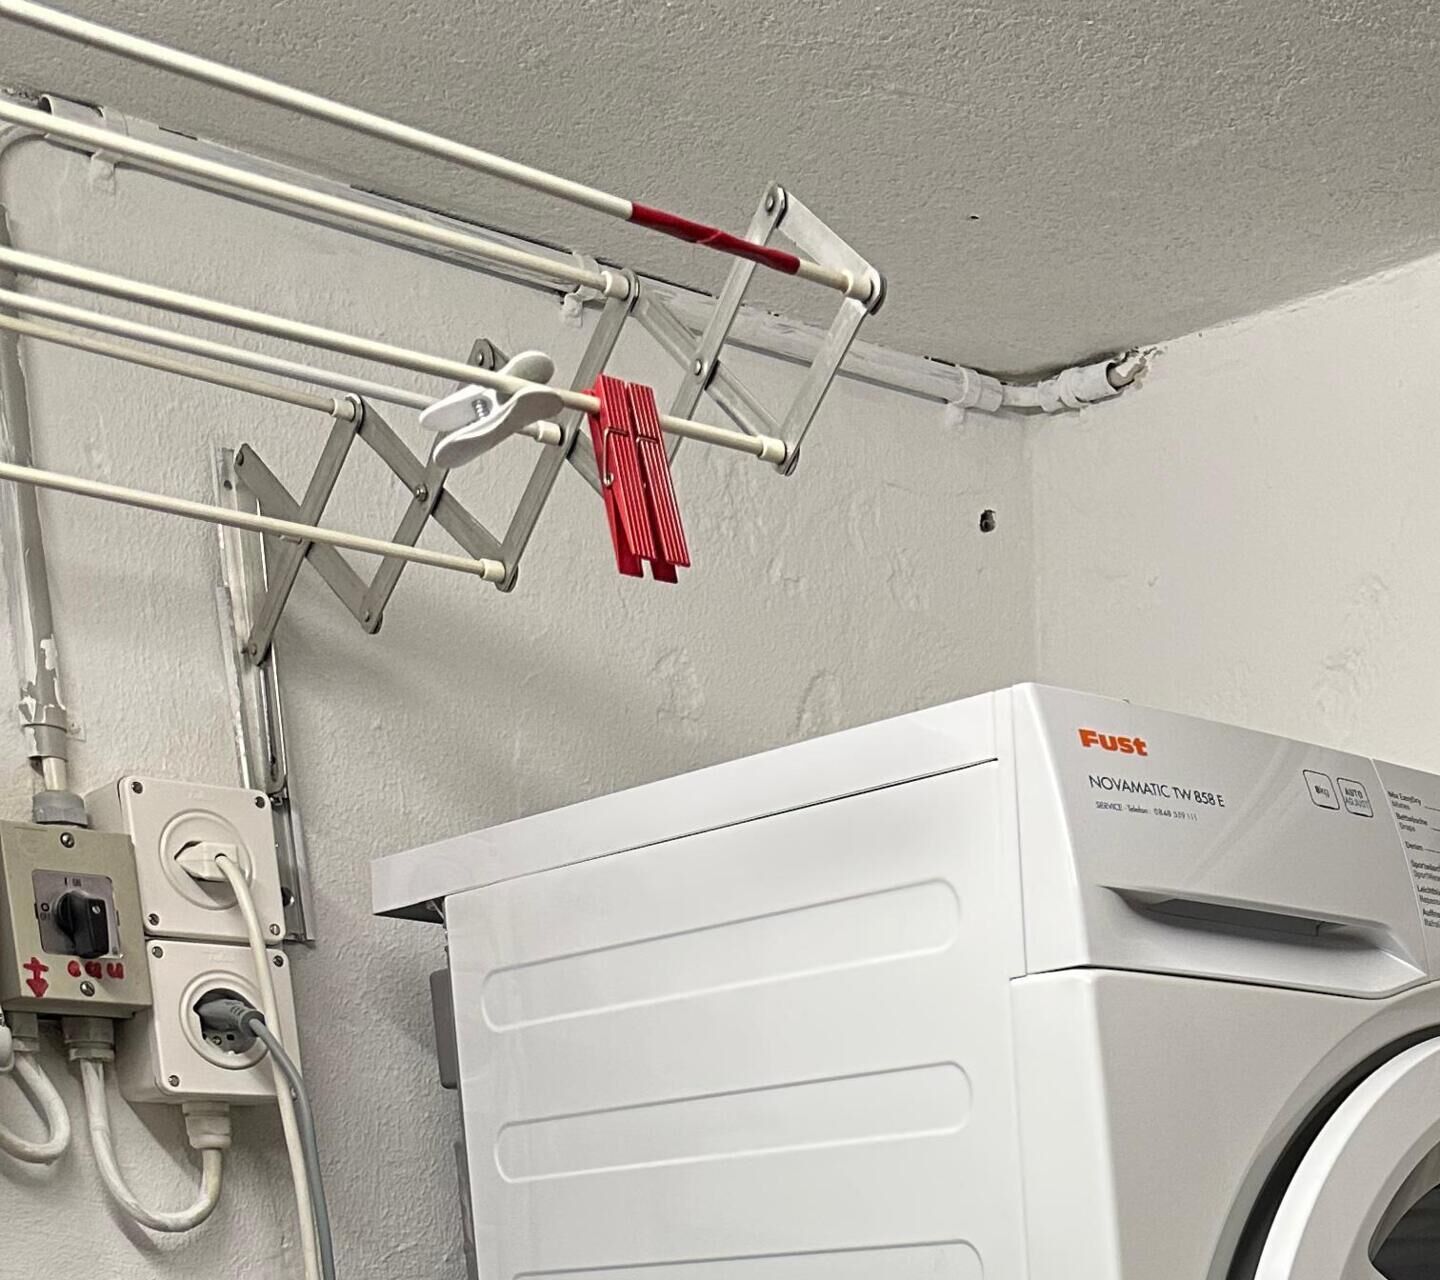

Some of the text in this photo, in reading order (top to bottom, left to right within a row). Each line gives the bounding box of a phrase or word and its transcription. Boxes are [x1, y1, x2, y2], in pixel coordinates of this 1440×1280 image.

[1078, 728, 1148, 756] Fust
[1088, 774, 1225, 807] NOVAMATIC TW 858 E
[1095, 801, 1122, 812] SERVICE
